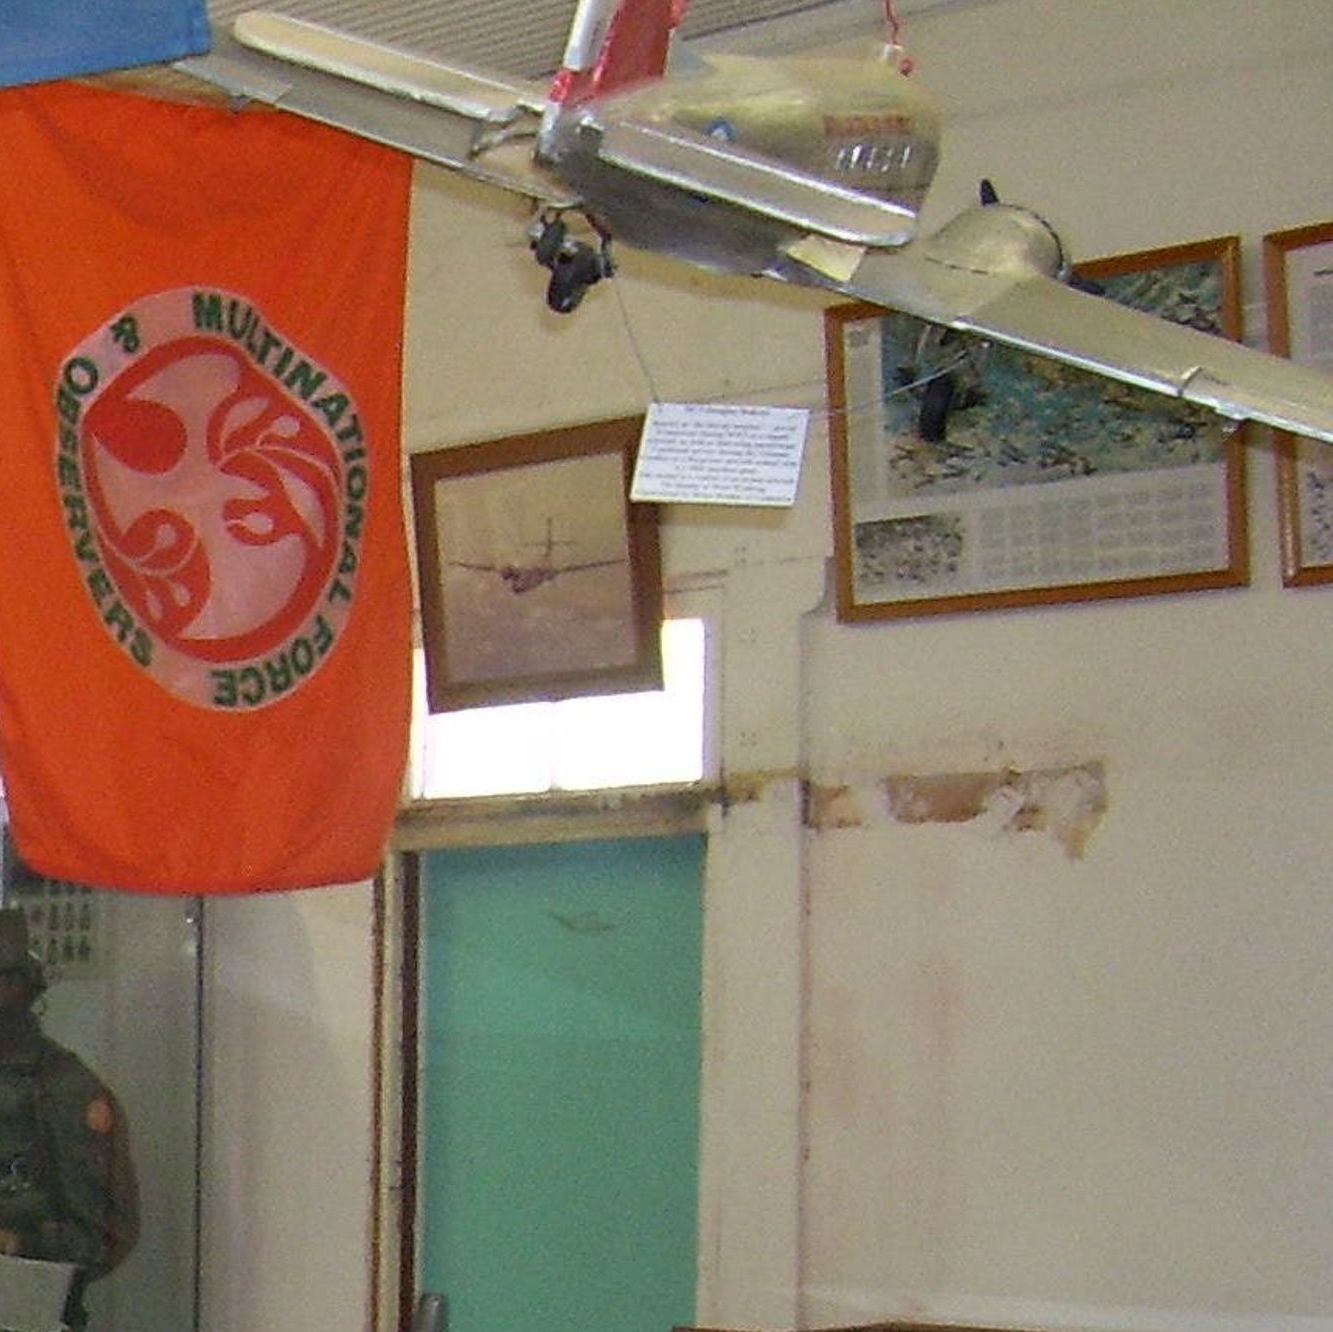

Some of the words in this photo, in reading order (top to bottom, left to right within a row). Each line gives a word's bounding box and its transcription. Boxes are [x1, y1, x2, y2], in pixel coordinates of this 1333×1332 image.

[56, 356, 154, 668] OBSERVERS
[191, 291, 365, 604] MULTINATIONAL
[211, 612, 334, 708] FORCE
